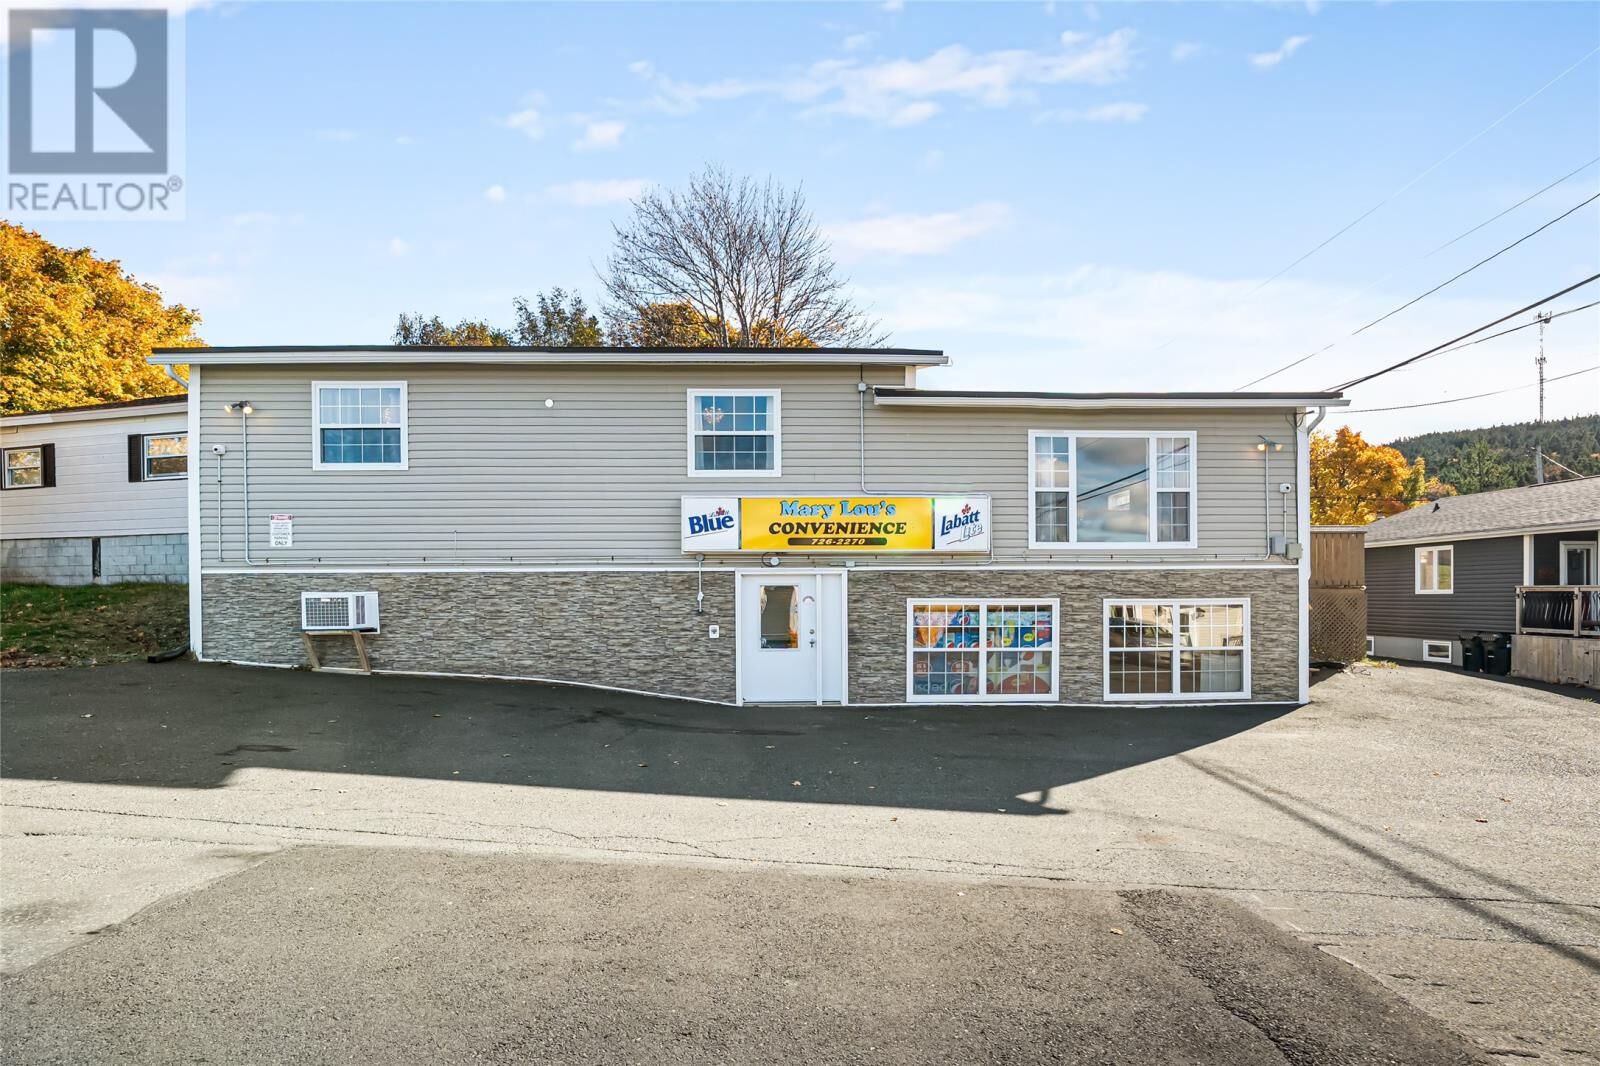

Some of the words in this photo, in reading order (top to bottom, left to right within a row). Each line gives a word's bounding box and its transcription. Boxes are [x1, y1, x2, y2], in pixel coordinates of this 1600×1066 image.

[780, 500, 835, 519] Mary
[840, 500, 897, 517] Lou's
[688, 514, 735, 535] Blue
[768, 522, 907, 535] CONVENIENCE
[940, 510, 981, 537] Labatt
